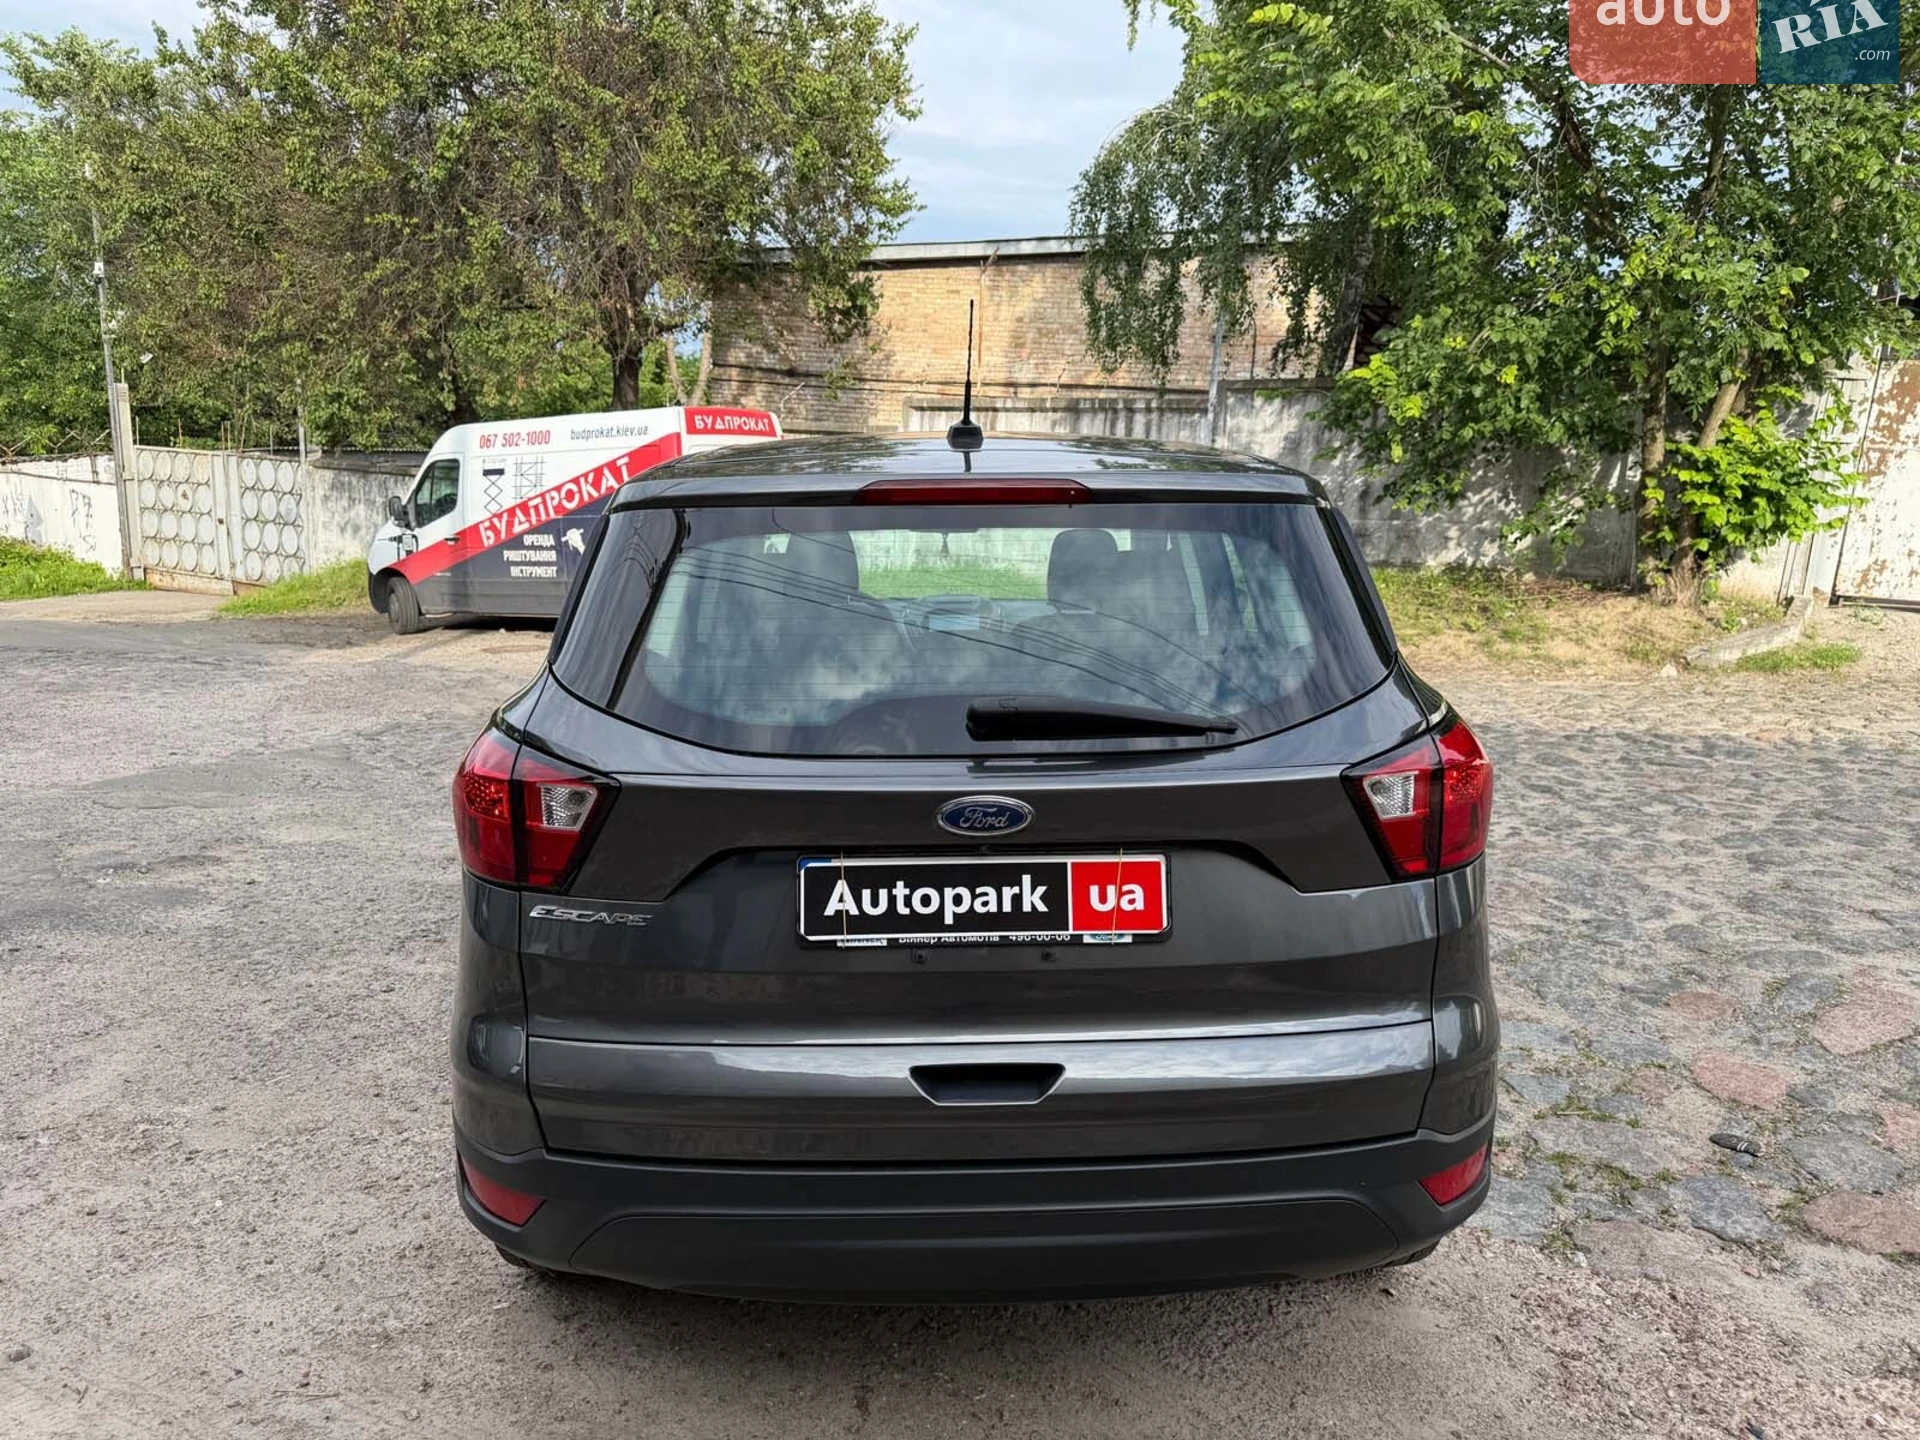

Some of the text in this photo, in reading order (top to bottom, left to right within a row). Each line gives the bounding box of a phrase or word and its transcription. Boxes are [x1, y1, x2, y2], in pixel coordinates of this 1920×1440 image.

[570, 424, 649, 442] budprokat.kiev.ua
[694, 414, 769, 432] БУДПРОКАТ
[479, 429, 551, 449] 067 502-1000
[478, 456, 630, 548] БУДПРОКАТ
[522, 534, 556, 548] ОРЕНДА
[503, 550, 557, 562] РИШТУВАННЯ
[959, 806, 1011, 828] Ford
[823, 873, 1146, 926] Autopark ua
[529, 905, 653, 926] ESCAPE
